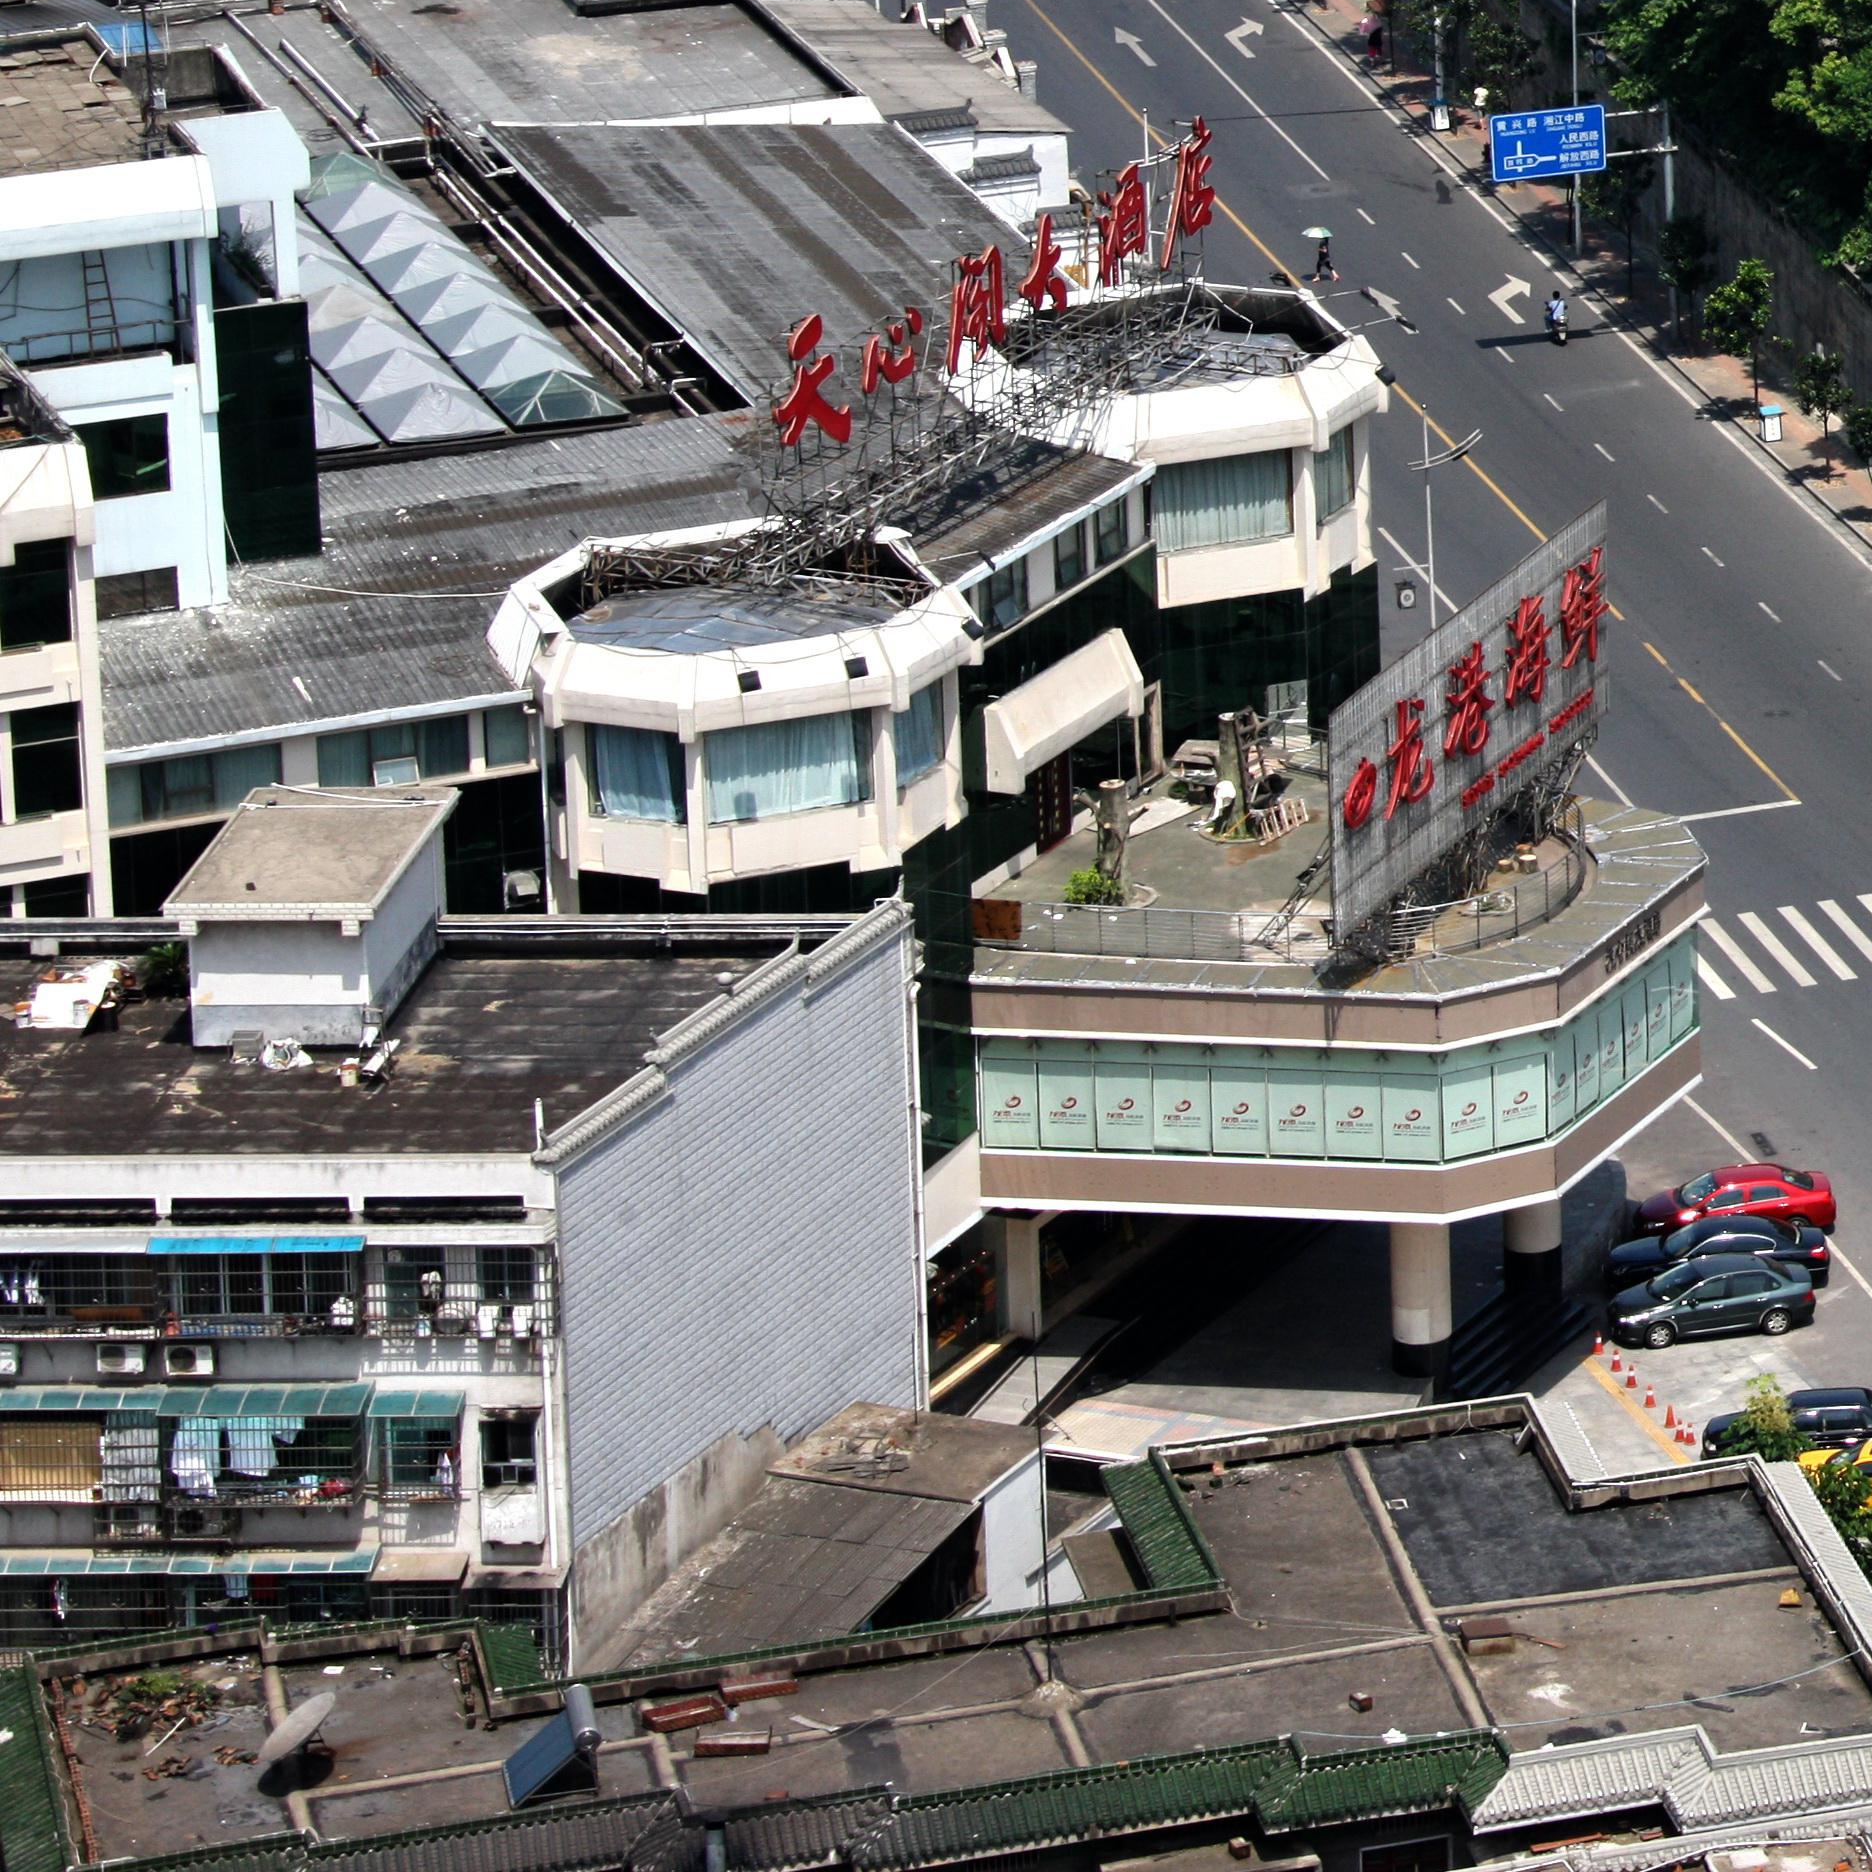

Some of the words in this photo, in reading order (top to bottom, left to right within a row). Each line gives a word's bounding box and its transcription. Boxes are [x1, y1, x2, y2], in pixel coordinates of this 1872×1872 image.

[1560, 131, 1599, 144] 人民西路
[772, 115, 1216, 446] 天心阁大酒店
